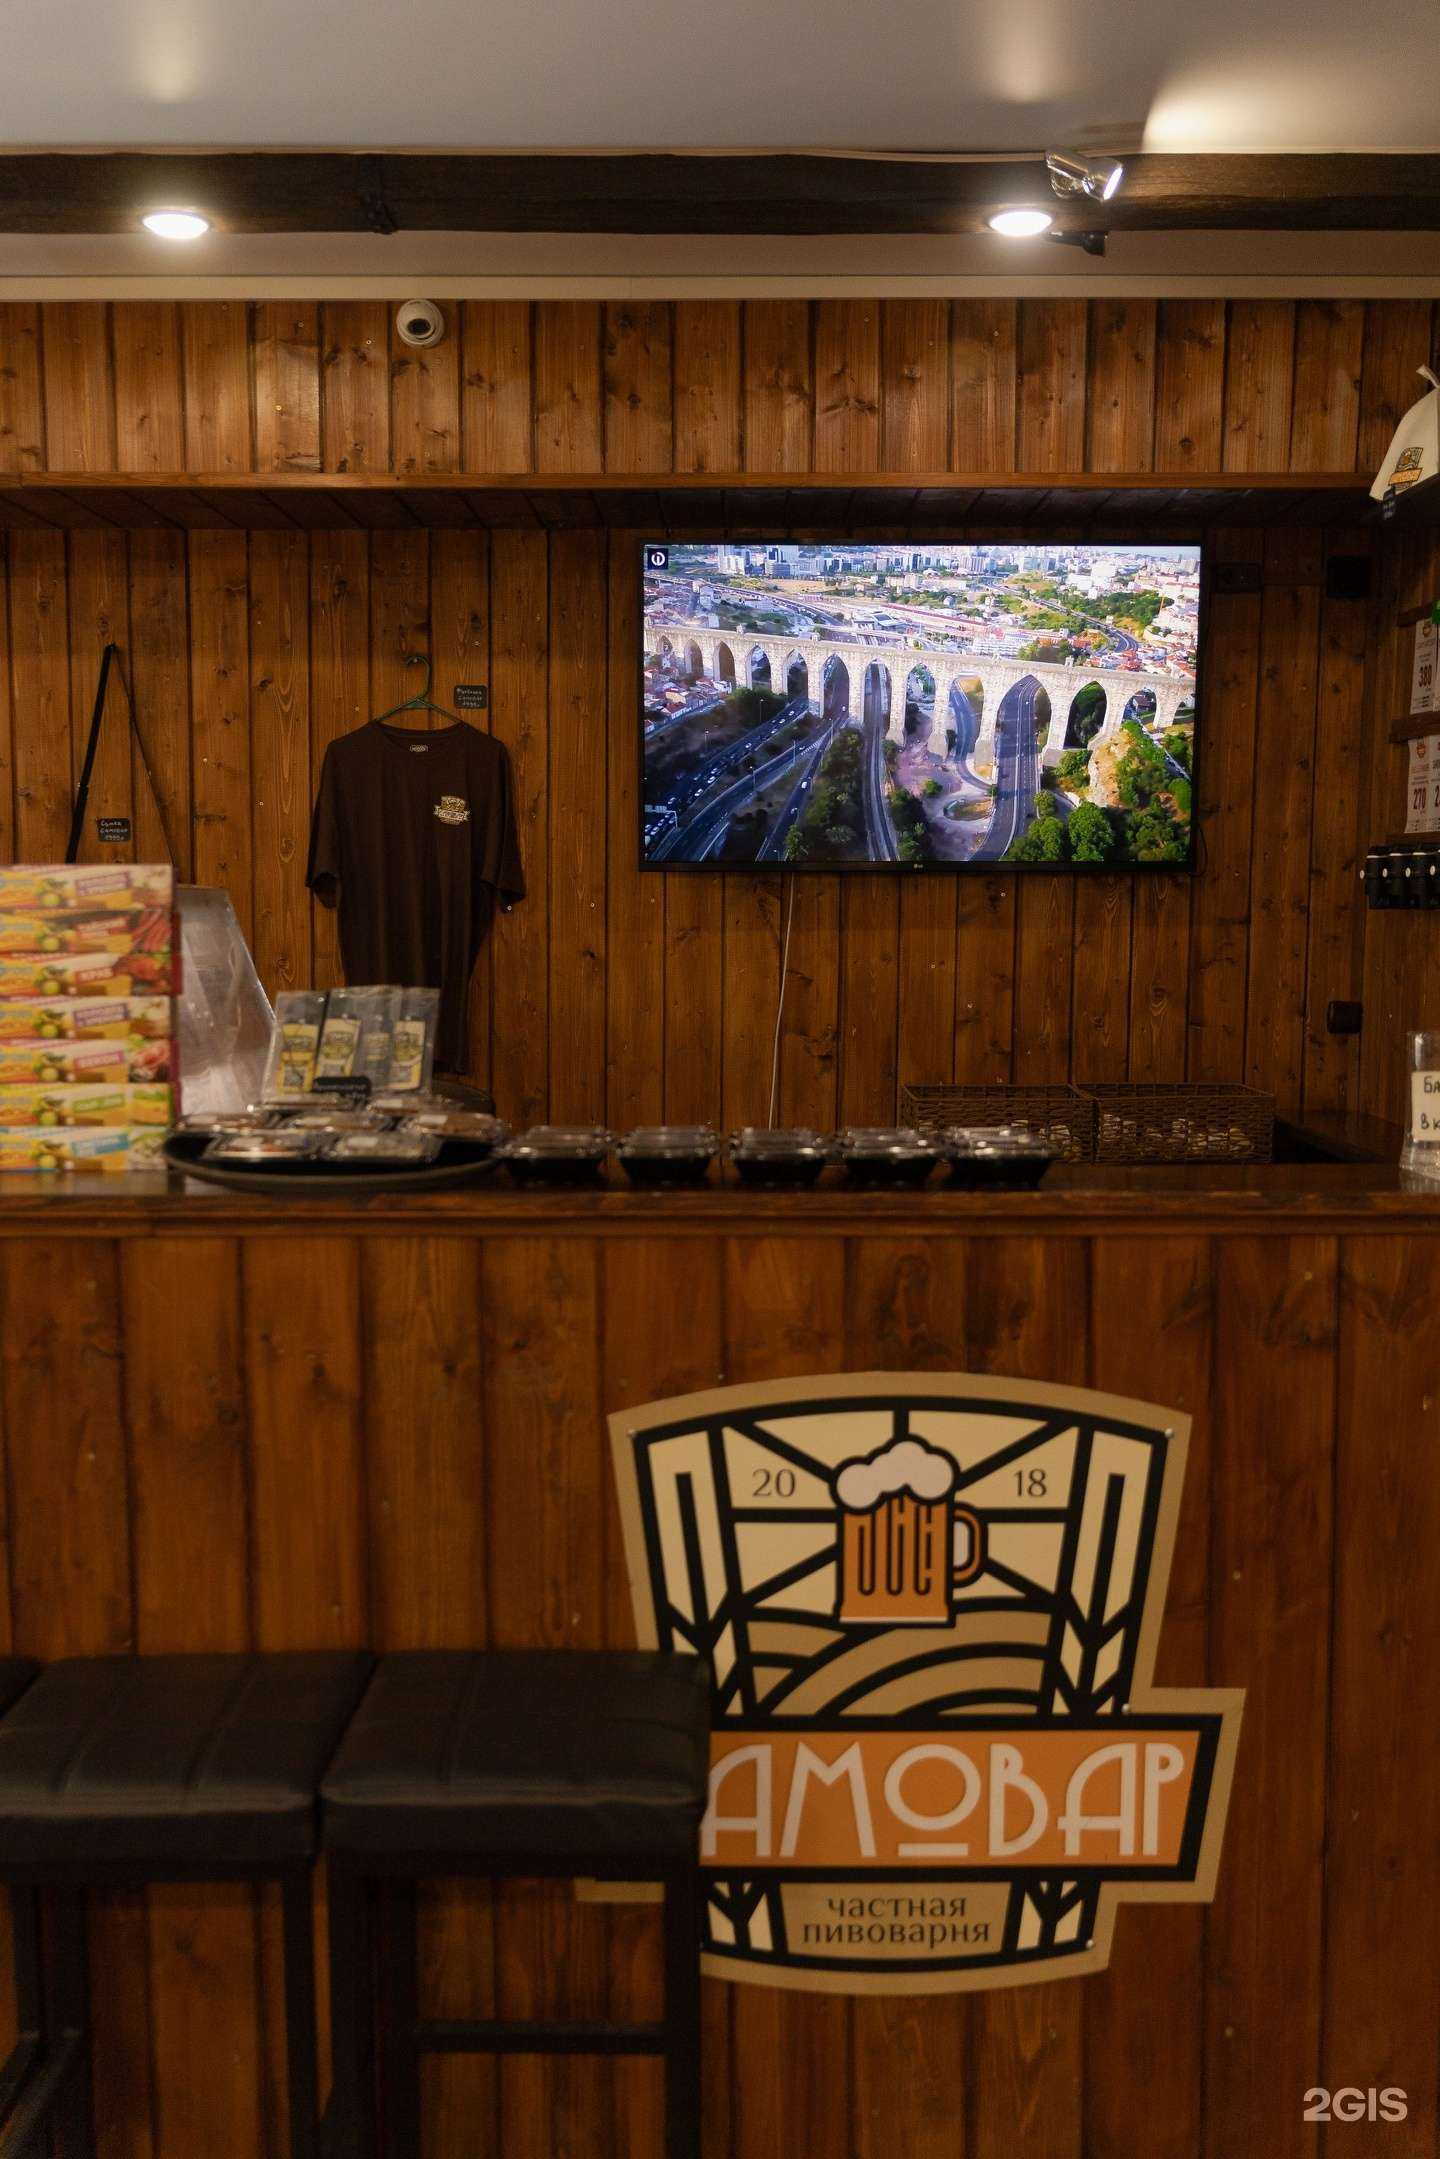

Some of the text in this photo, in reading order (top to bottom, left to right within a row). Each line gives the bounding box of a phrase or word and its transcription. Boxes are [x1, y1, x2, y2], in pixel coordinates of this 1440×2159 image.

[752, 1468, 795, 1497] 20
[1014, 1468, 1047, 1497] 18
[701, 1741, 1184, 1858] АМОВАР
[827, 1897, 967, 1918] частная
[803, 1922, 990, 1949] пивоварня
